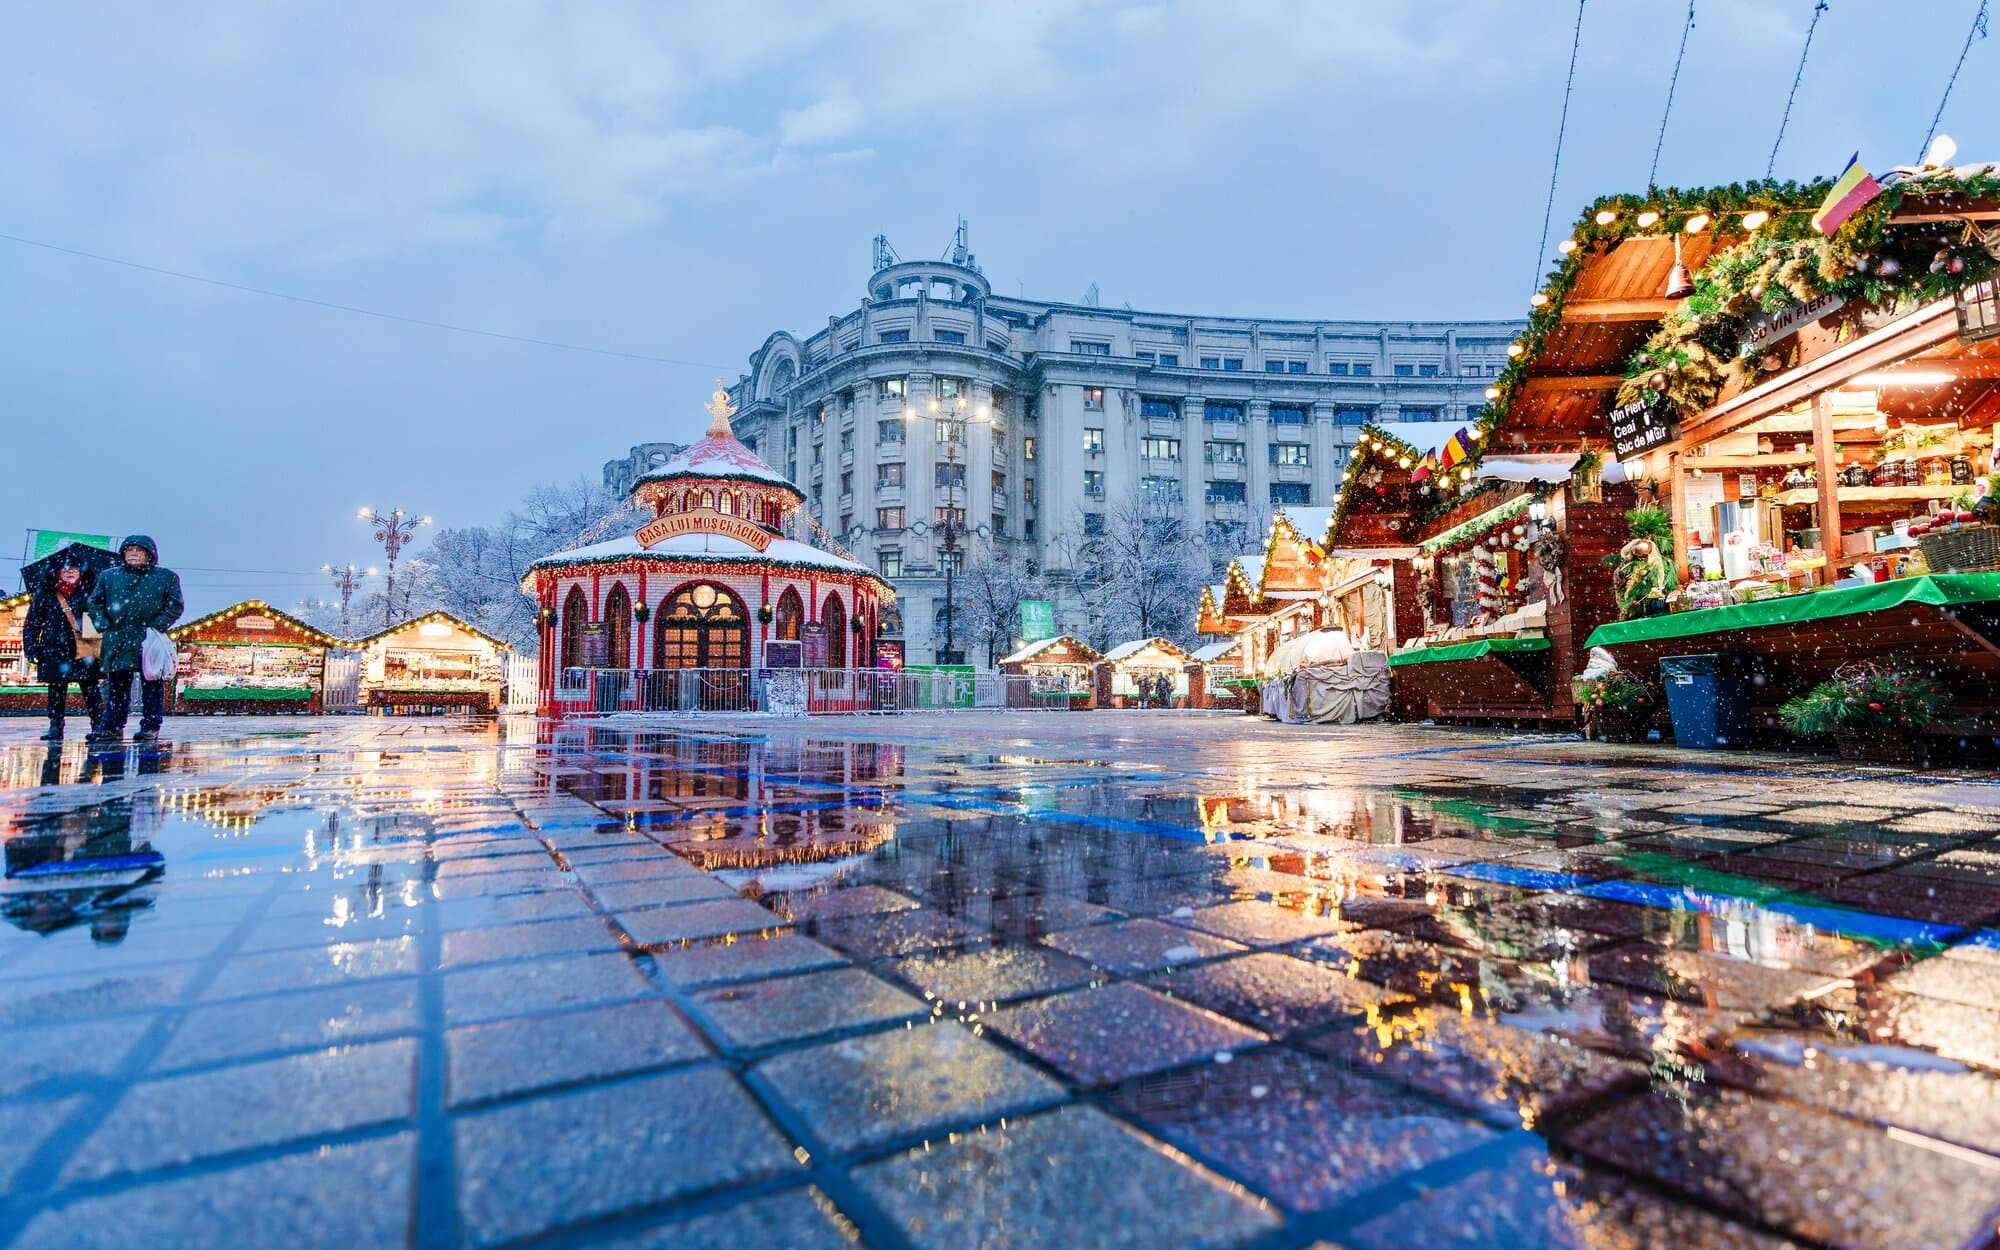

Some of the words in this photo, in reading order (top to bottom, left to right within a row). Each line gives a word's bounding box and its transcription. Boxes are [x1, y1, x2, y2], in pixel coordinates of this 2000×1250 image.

[1770, 313, 1793, 333] VIN
[1609, 409, 1626, 423] Vin
[1624, 398, 1647, 416] Fiert
[1614, 419, 1637, 439] Ceai
[1617, 440, 1634, 455] Suc
[1634, 435, 1646, 448] de
[640, 522, 669, 543] CASA
[670, 517, 690, 532] LUI
[719, 519, 767, 547] CRACIUN
